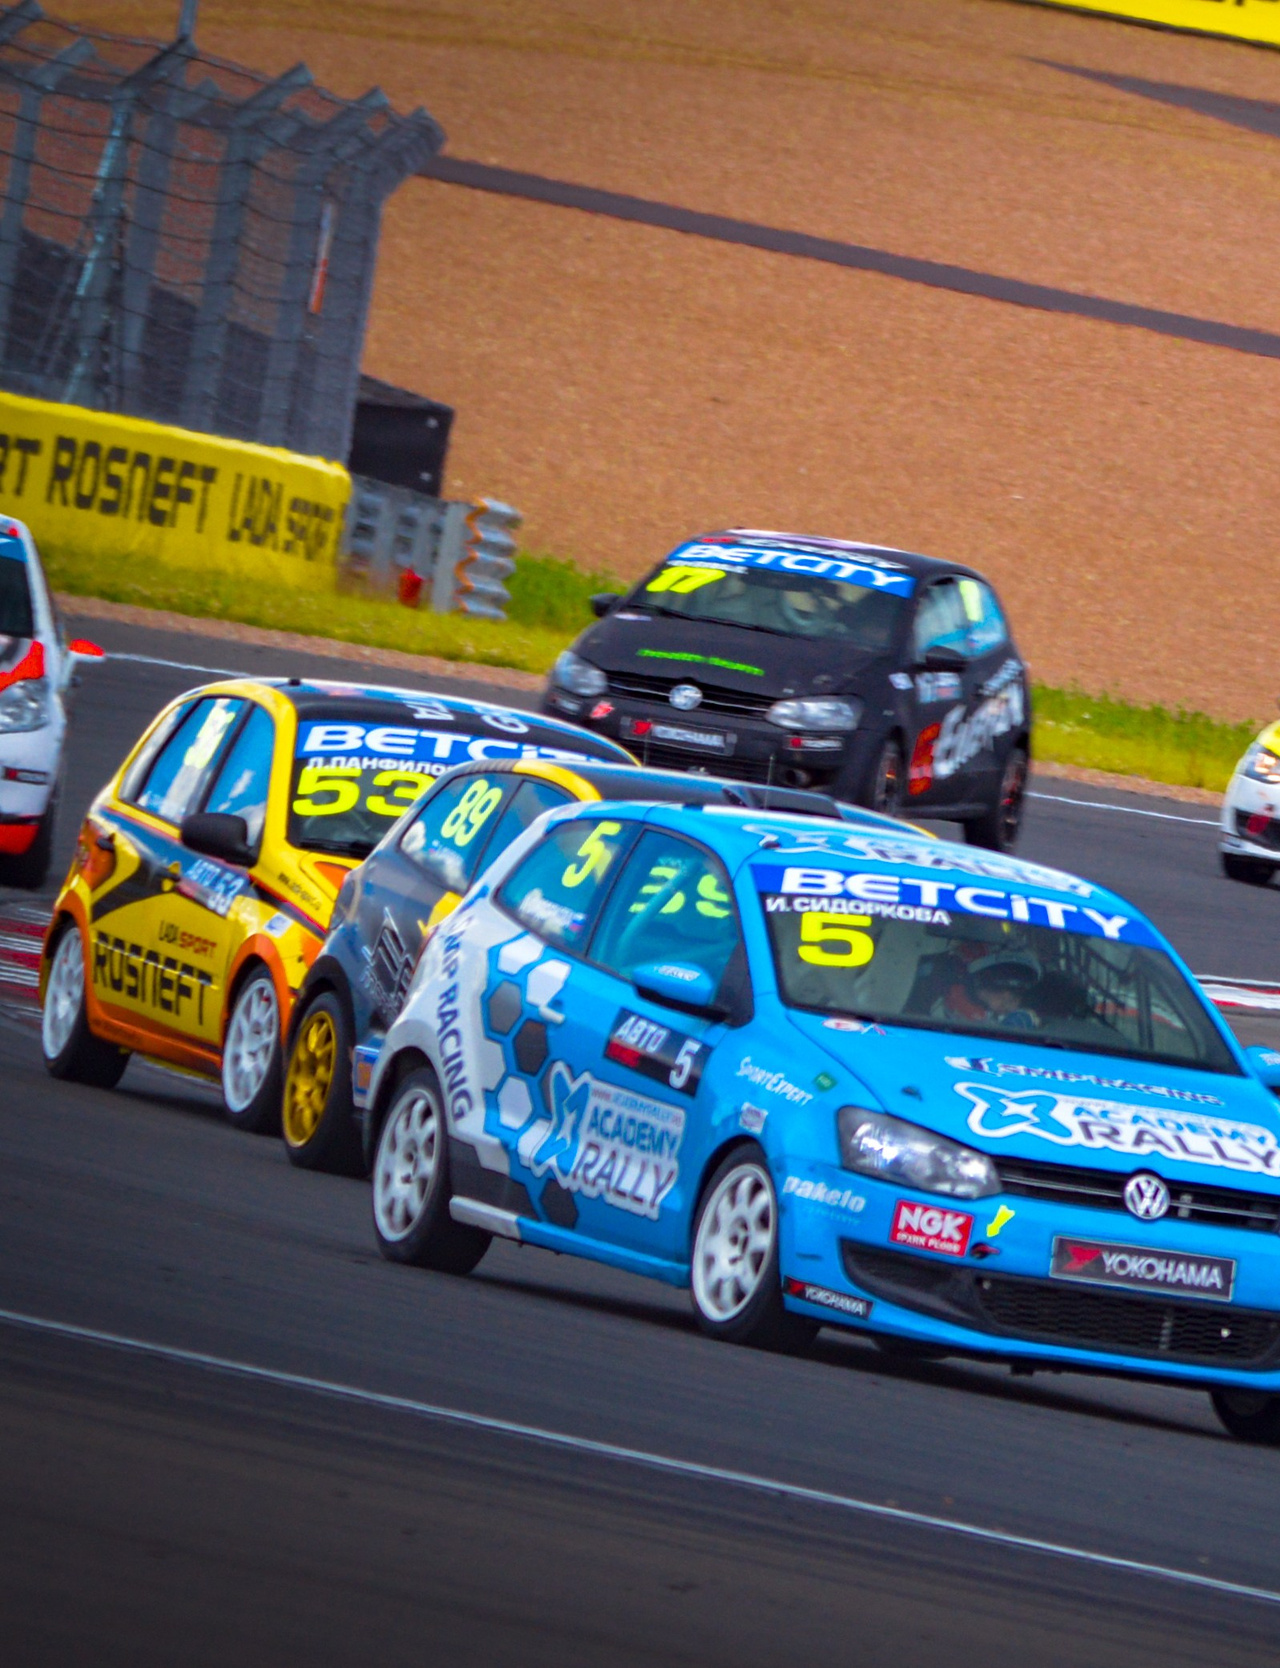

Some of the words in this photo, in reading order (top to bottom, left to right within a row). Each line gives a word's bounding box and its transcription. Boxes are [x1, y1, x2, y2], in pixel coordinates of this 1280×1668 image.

[46, 435, 218, 534] ROSNEFT
[645, 565, 727, 594] 17
[677, 544, 910, 587] BETCITY
[292, 766, 436, 817] 53
[306, 756, 456, 777] Л.ПАНФИЛО
[441, 778, 503, 847] 89
[562, 822, 621, 888] 5
[765, 896, 952, 926] И.СИДОРКОВА
[781, 867, 1128, 939] BETCITY
[797, 910, 875, 968] 5
[93, 931, 213, 1026] ROSNEFT
[437, 982, 474, 1122] RACING
[614, 1014, 669, 1054] АВТО
[669, 1038, 702, 1089] 5
[586, 1105, 677, 1157] ACADEMY
[1073, 1105, 1268, 1146] ACADEMY
[1077, 1121, 1276, 1170] RALLY
[571, 1141, 675, 1209] RALLY
[897, 1205, 966, 1242] NGK
[1101, 1250, 1223, 1290] YOKOHAMA
[804, 1285, 864, 1316] YOKOHAMA
